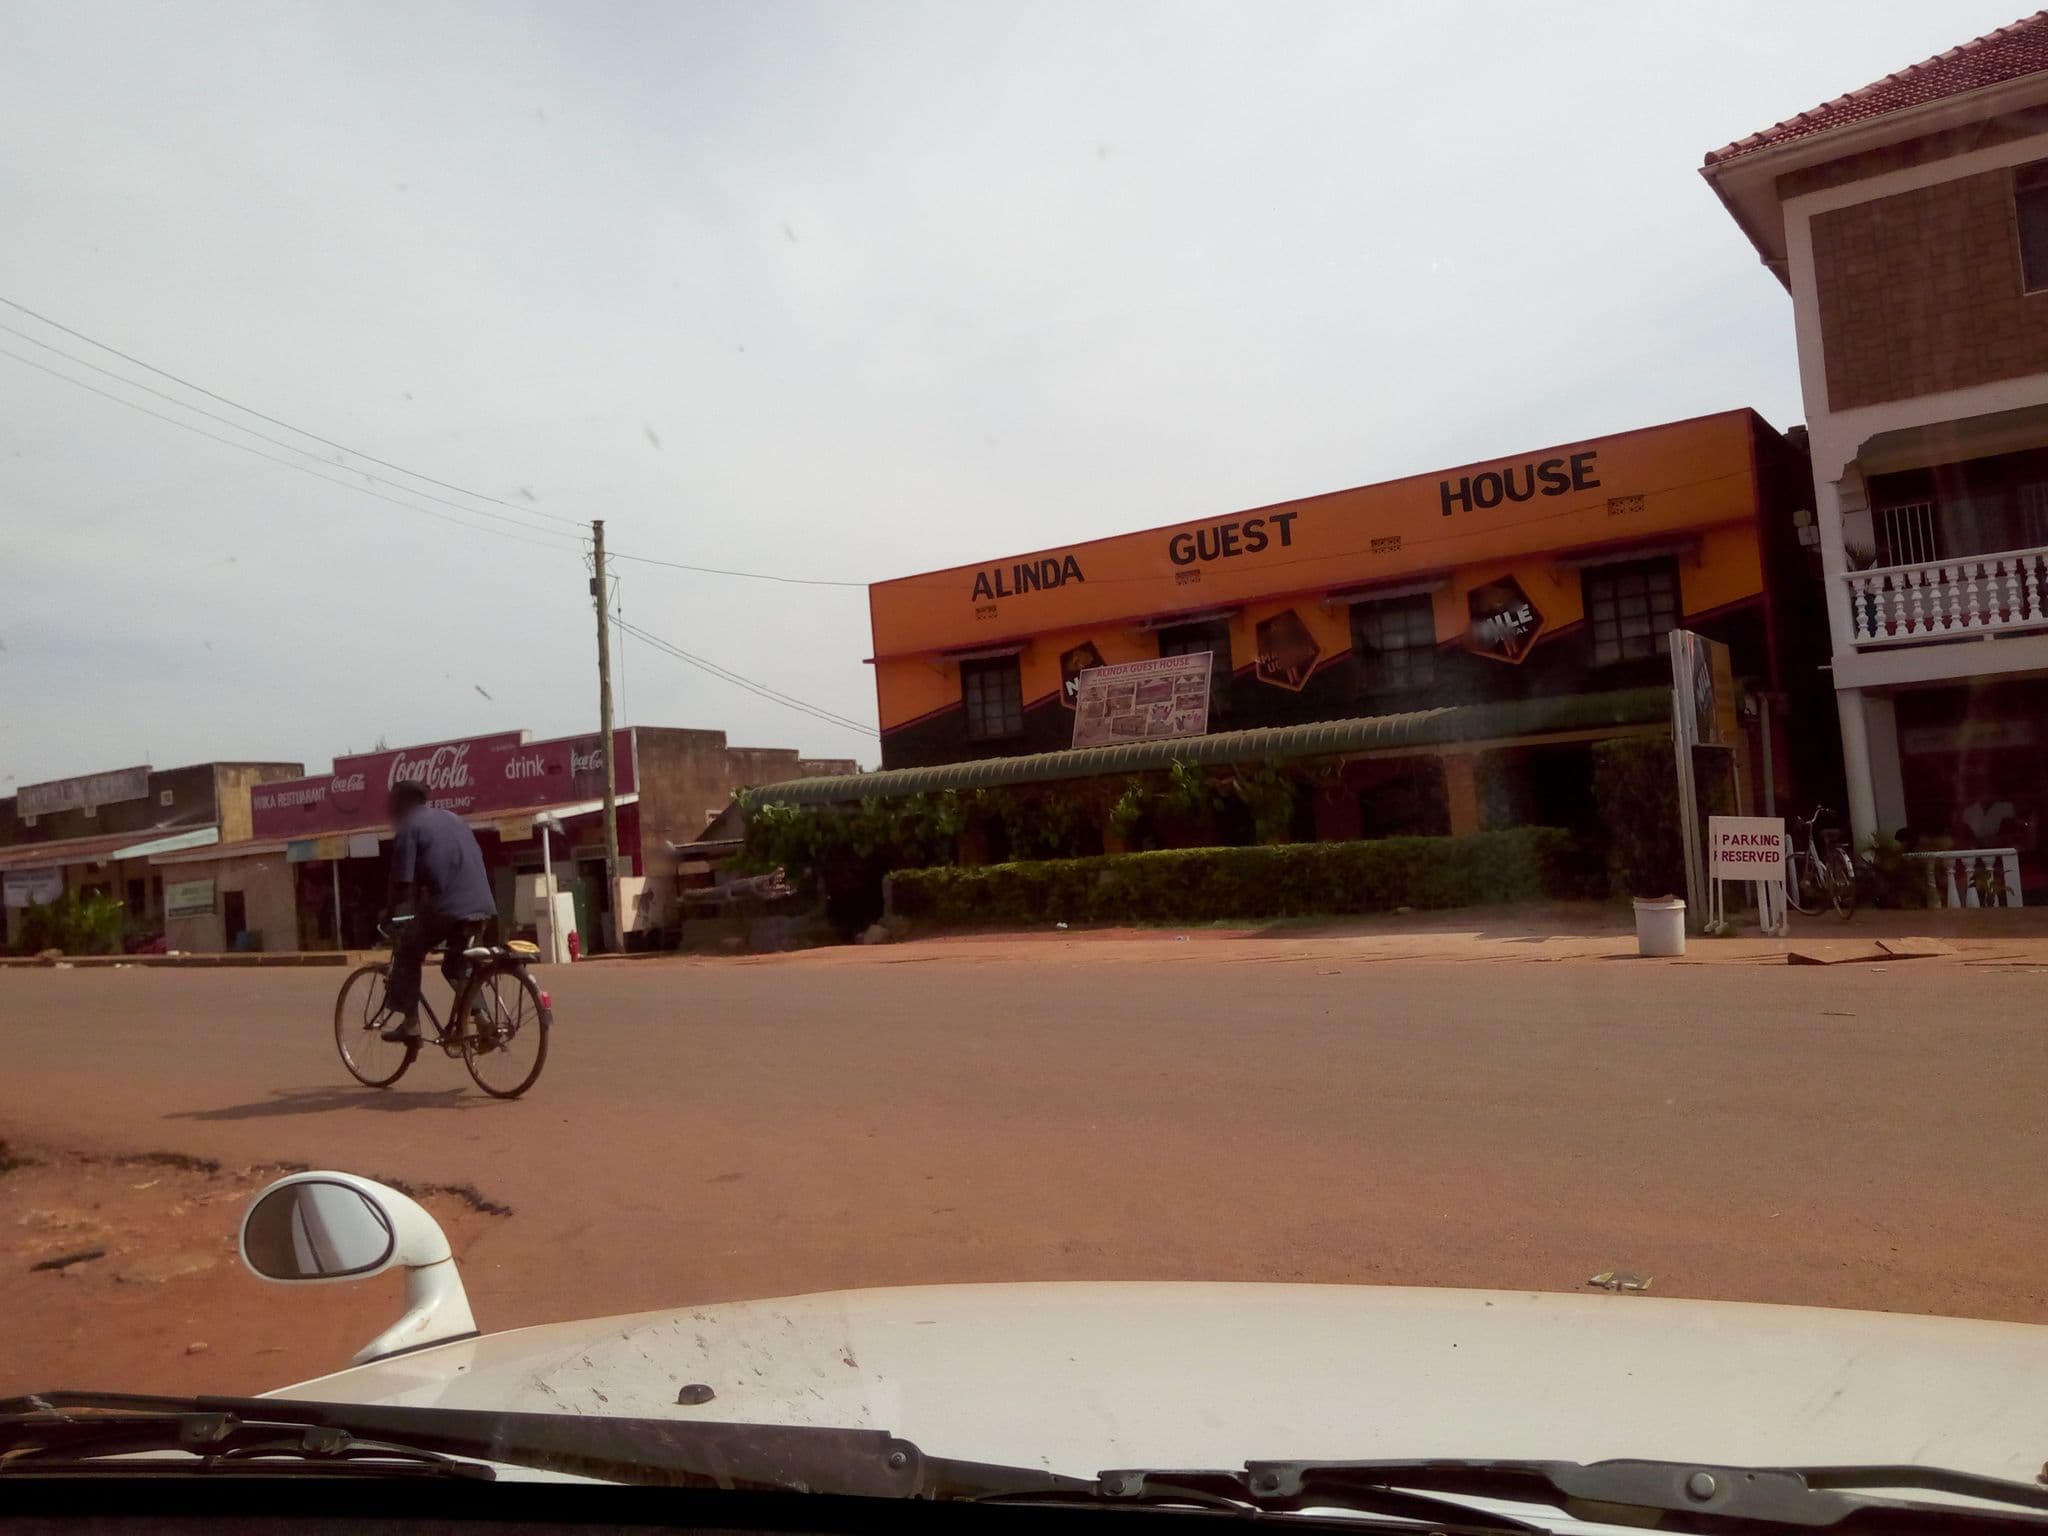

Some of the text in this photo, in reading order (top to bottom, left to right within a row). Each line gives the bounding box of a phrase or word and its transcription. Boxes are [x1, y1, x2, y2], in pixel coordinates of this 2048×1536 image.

[972, 451, 1601, 602] ALINDA GUEST HOUSE
[1096, 666, 1128, 678] ALINDA
[1129, 661, 1158, 673] GUEST
[1159, 656, 1191, 669] HOUSE
[387, 743, 469, 792] Coca-Cola
[505, 748, 603, 780] drink Coca-Co
[1722, 834, 1780, 847] PARKING
[1721, 850, 1780, 863] RESERVED
